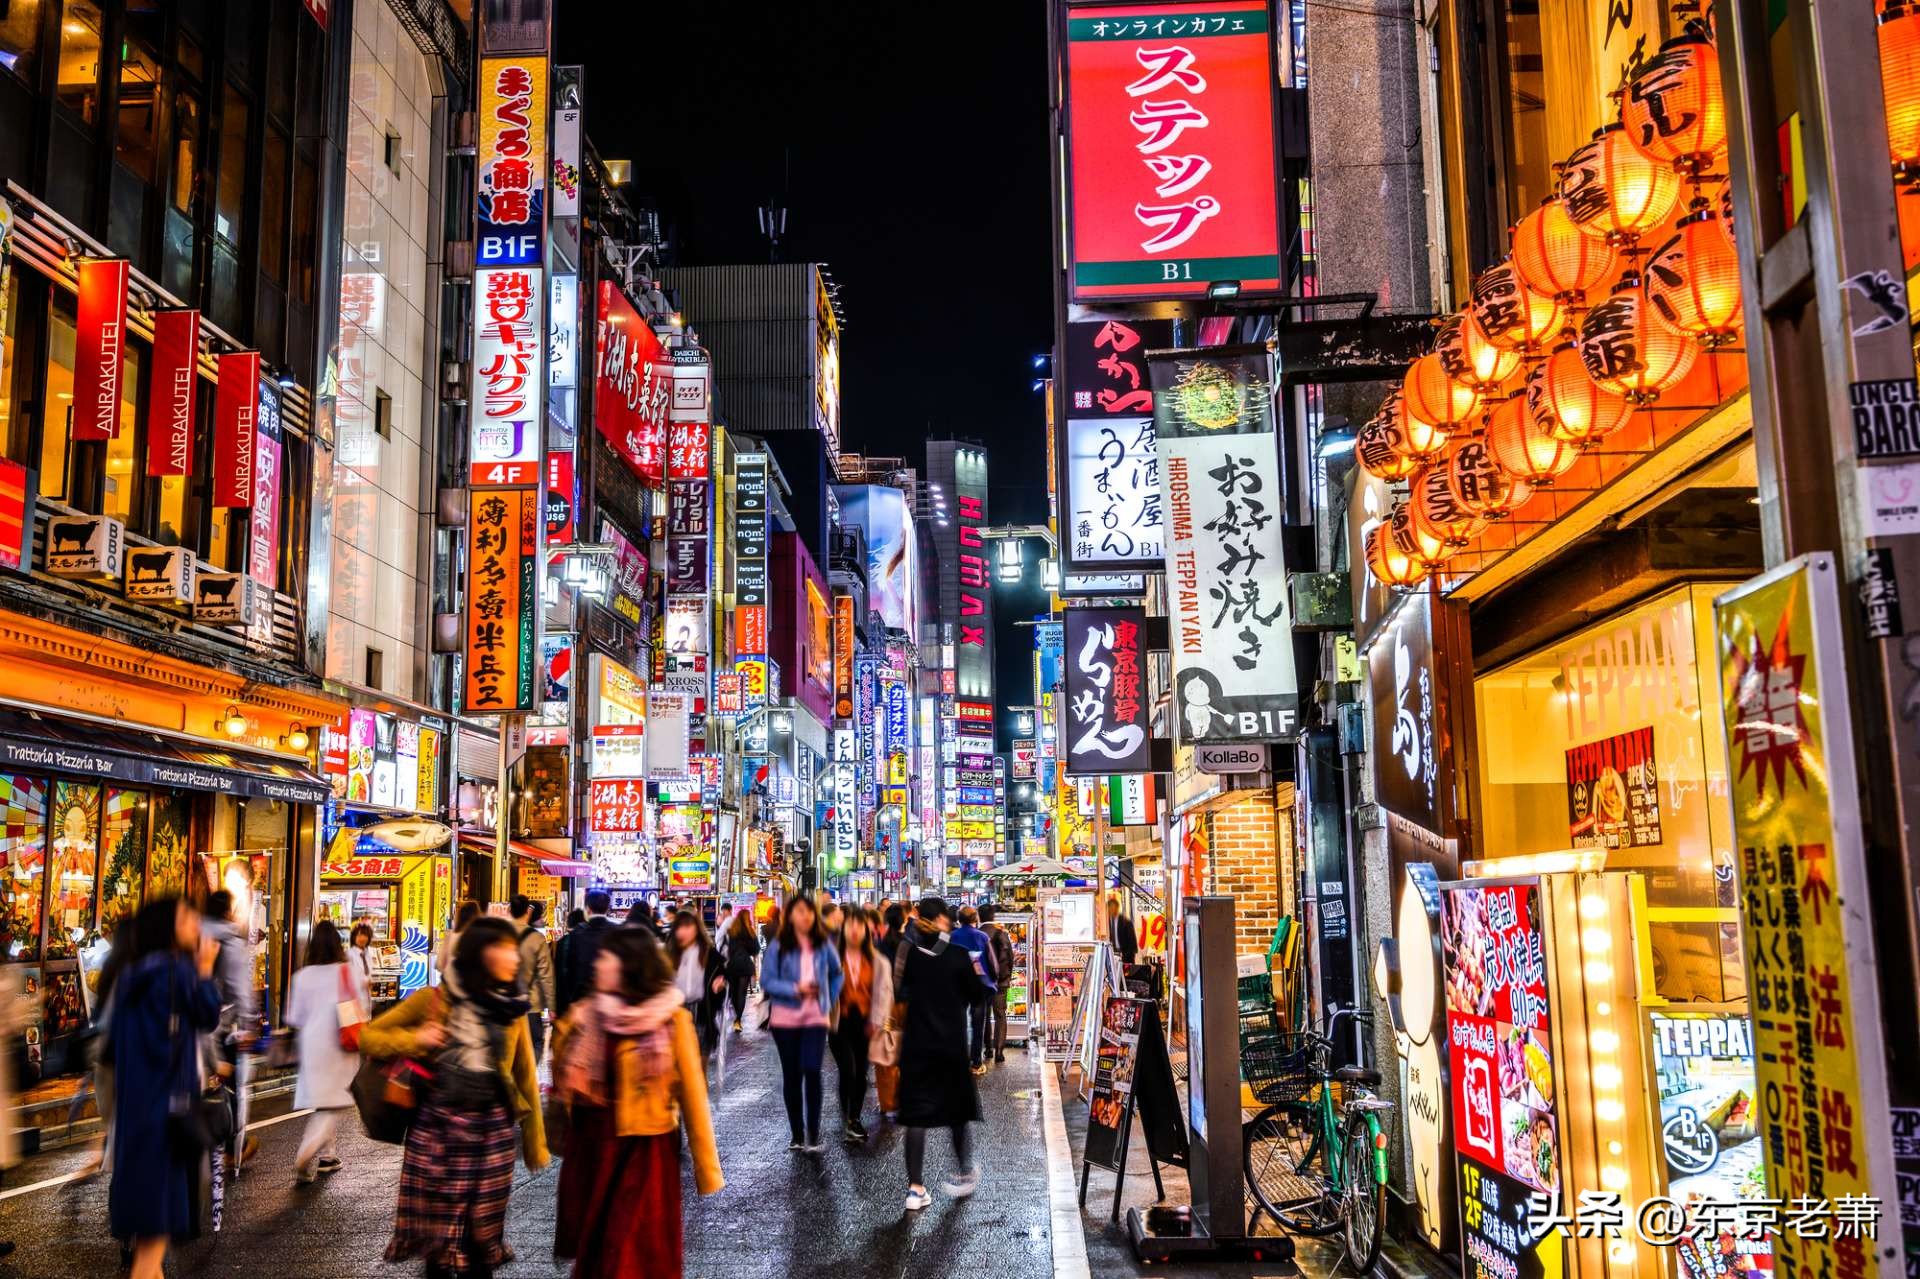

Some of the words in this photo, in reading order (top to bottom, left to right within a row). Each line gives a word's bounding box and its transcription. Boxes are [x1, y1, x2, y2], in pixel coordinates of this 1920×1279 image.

[1093, 17, 1246, 37] オンラインカフェ
[488, 66, 533, 225] まぐろ商店
[1125, 45, 1221, 254] ステップ
[483, 236, 537, 259] B1F
[1162, 262, 1193, 280] B1
[97, 322, 119, 435] ANRAKUTEI
[171, 367, 191, 474] ANRAKUTEI
[235, 405, 254, 505] ANRAKUTEI
[488, 464, 522, 484] 4F
[689, 483, 703, 533] レンタル
[1168, 457, 1193, 541] HIROSHIMA
[108, 524, 118, 573] BBQ
[1077, 510, 1094, 558] 一番街
[47, 555, 100, 570] 黒毛和牛
[182, 552, 190, 596] BBQ
[678, 541, 695, 578] エデン
[1203, 453, 1285, 671] お好み焼き
[128, 583, 175, 598] 黒毛和牛
[196, 607, 239, 621] 黒毛和牛
[668, 677, 704, 685] XROSS
[1112, 620, 1140, 723] 東京豚骨
[892, 688, 903, 734] カラオケ
[1239, 709, 1295, 734] B1F
[532, 731, 557, 745] 2F
[7, 745, 53, 766] Trattoria
[55, 751, 95, 772] Pizzeria
[96, 757, 113, 772] Bar
[1203, 750, 1260, 764] KollaBo
[154, 767, 186, 786] Trattoria
[188, 772, 218, 789] Pizzeria
[219, 777, 233, 790] Bar
[263, 784, 289, 798] Trattoria
[290, 787, 312, 800] Pizzeria
[313, 790, 324, 802] Bar
[1128, 775, 1139, 814] タリアン
[1484, 928, 1545, 990] 炭火焼鳥
[1464, 1163, 1479, 1197] 1F
[1465, 1197, 1482, 1229] 2F
